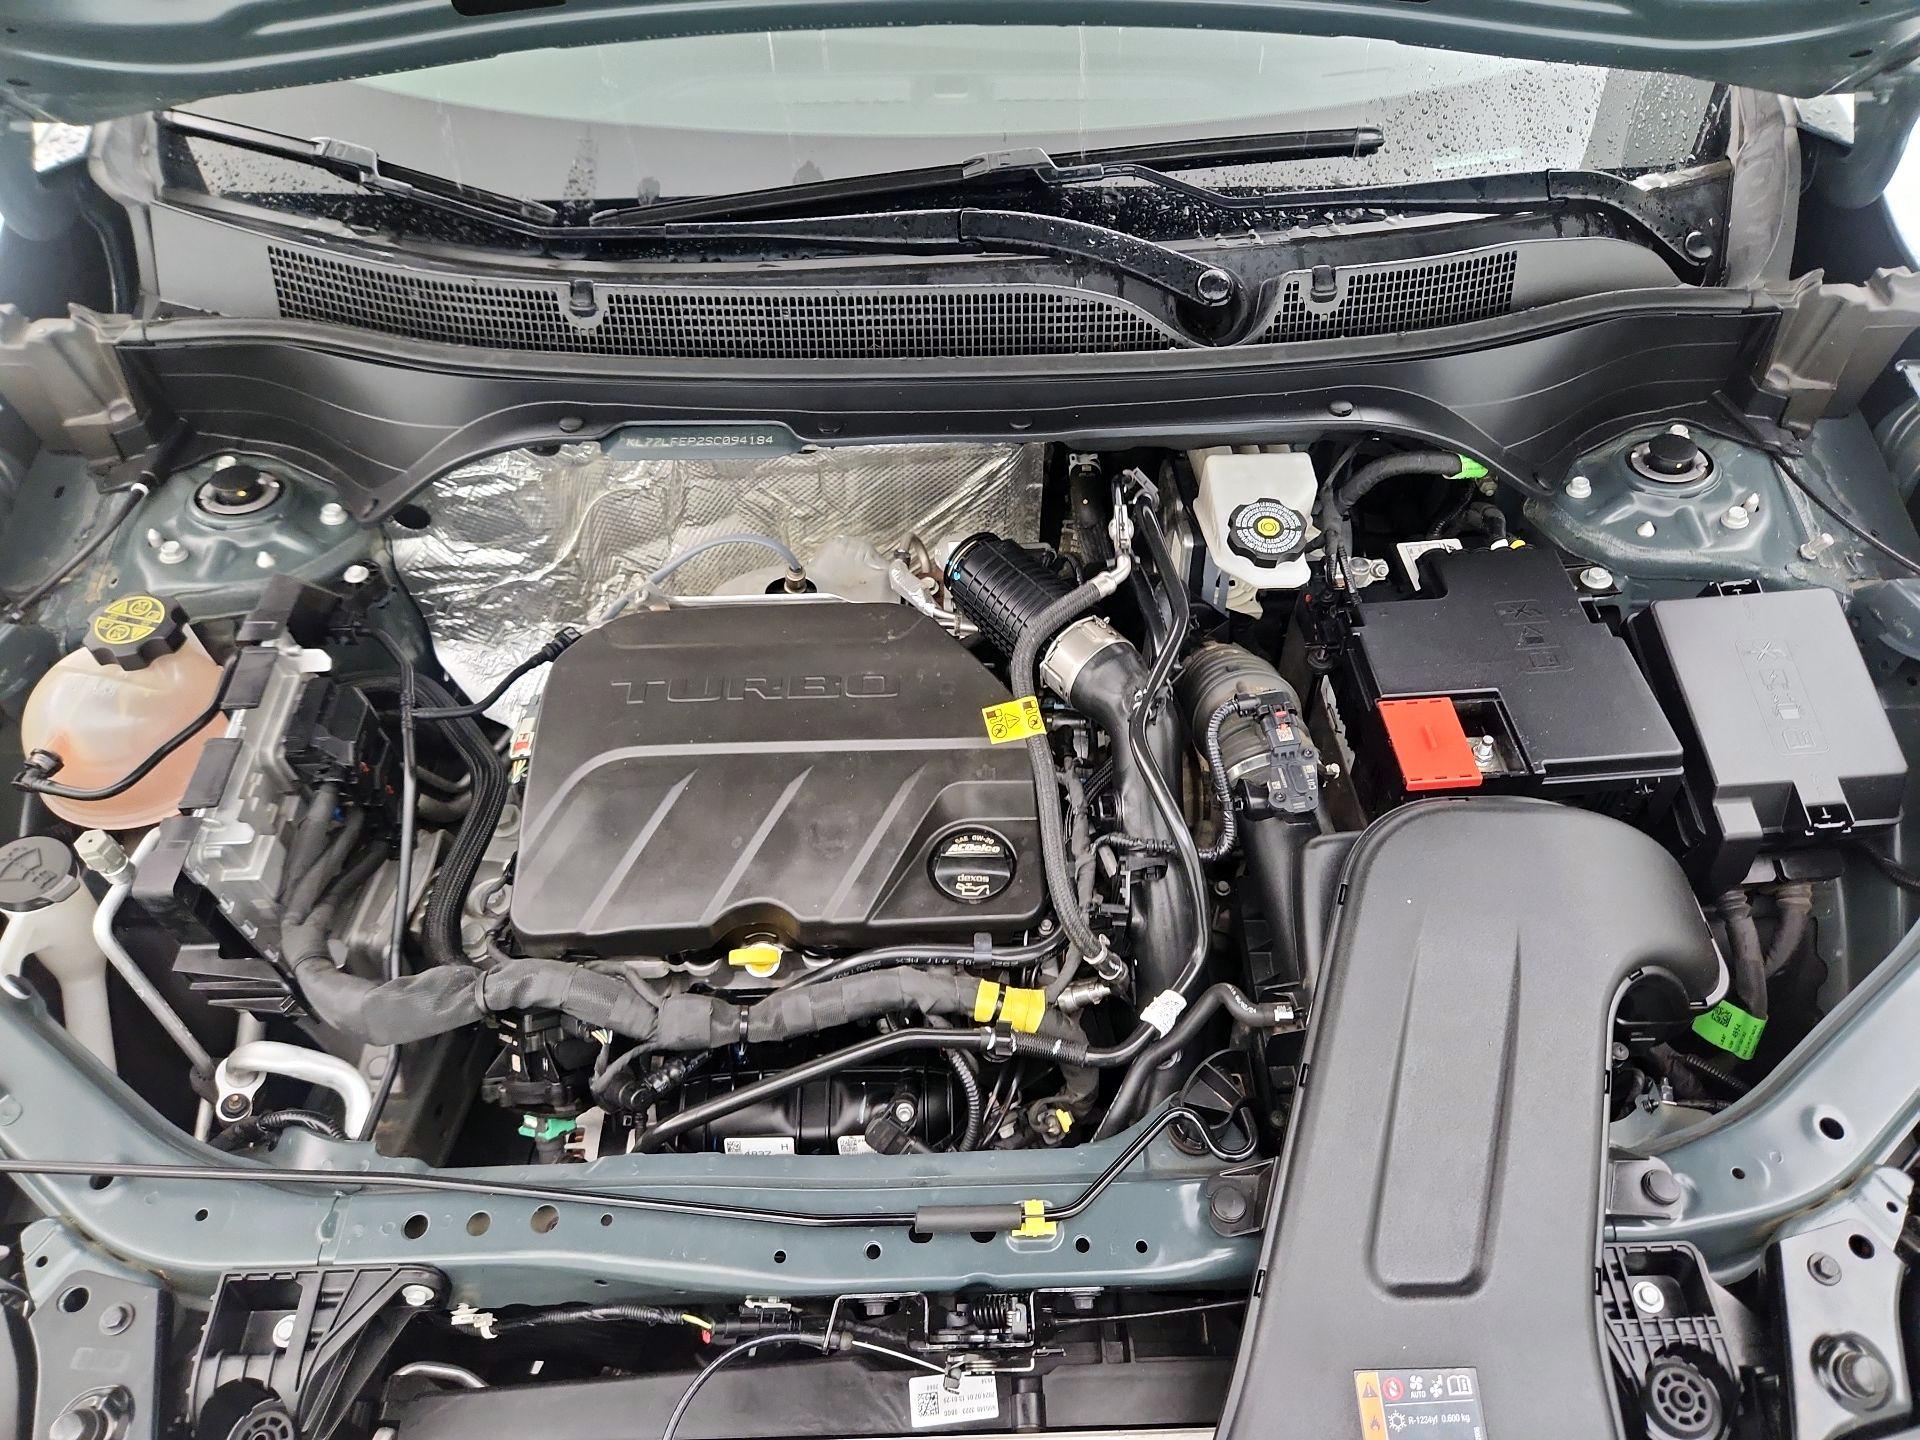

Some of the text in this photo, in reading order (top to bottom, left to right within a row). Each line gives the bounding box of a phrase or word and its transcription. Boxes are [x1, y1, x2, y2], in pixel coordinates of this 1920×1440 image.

[611, 673, 899, 704] TURBO
[946, 844, 1000, 853] ACDelco
[957, 874, 990, 883] dexos
[1410, 1390, 1426, 1399] AUTO
[1460, 1413, 1471, 1424] kg
